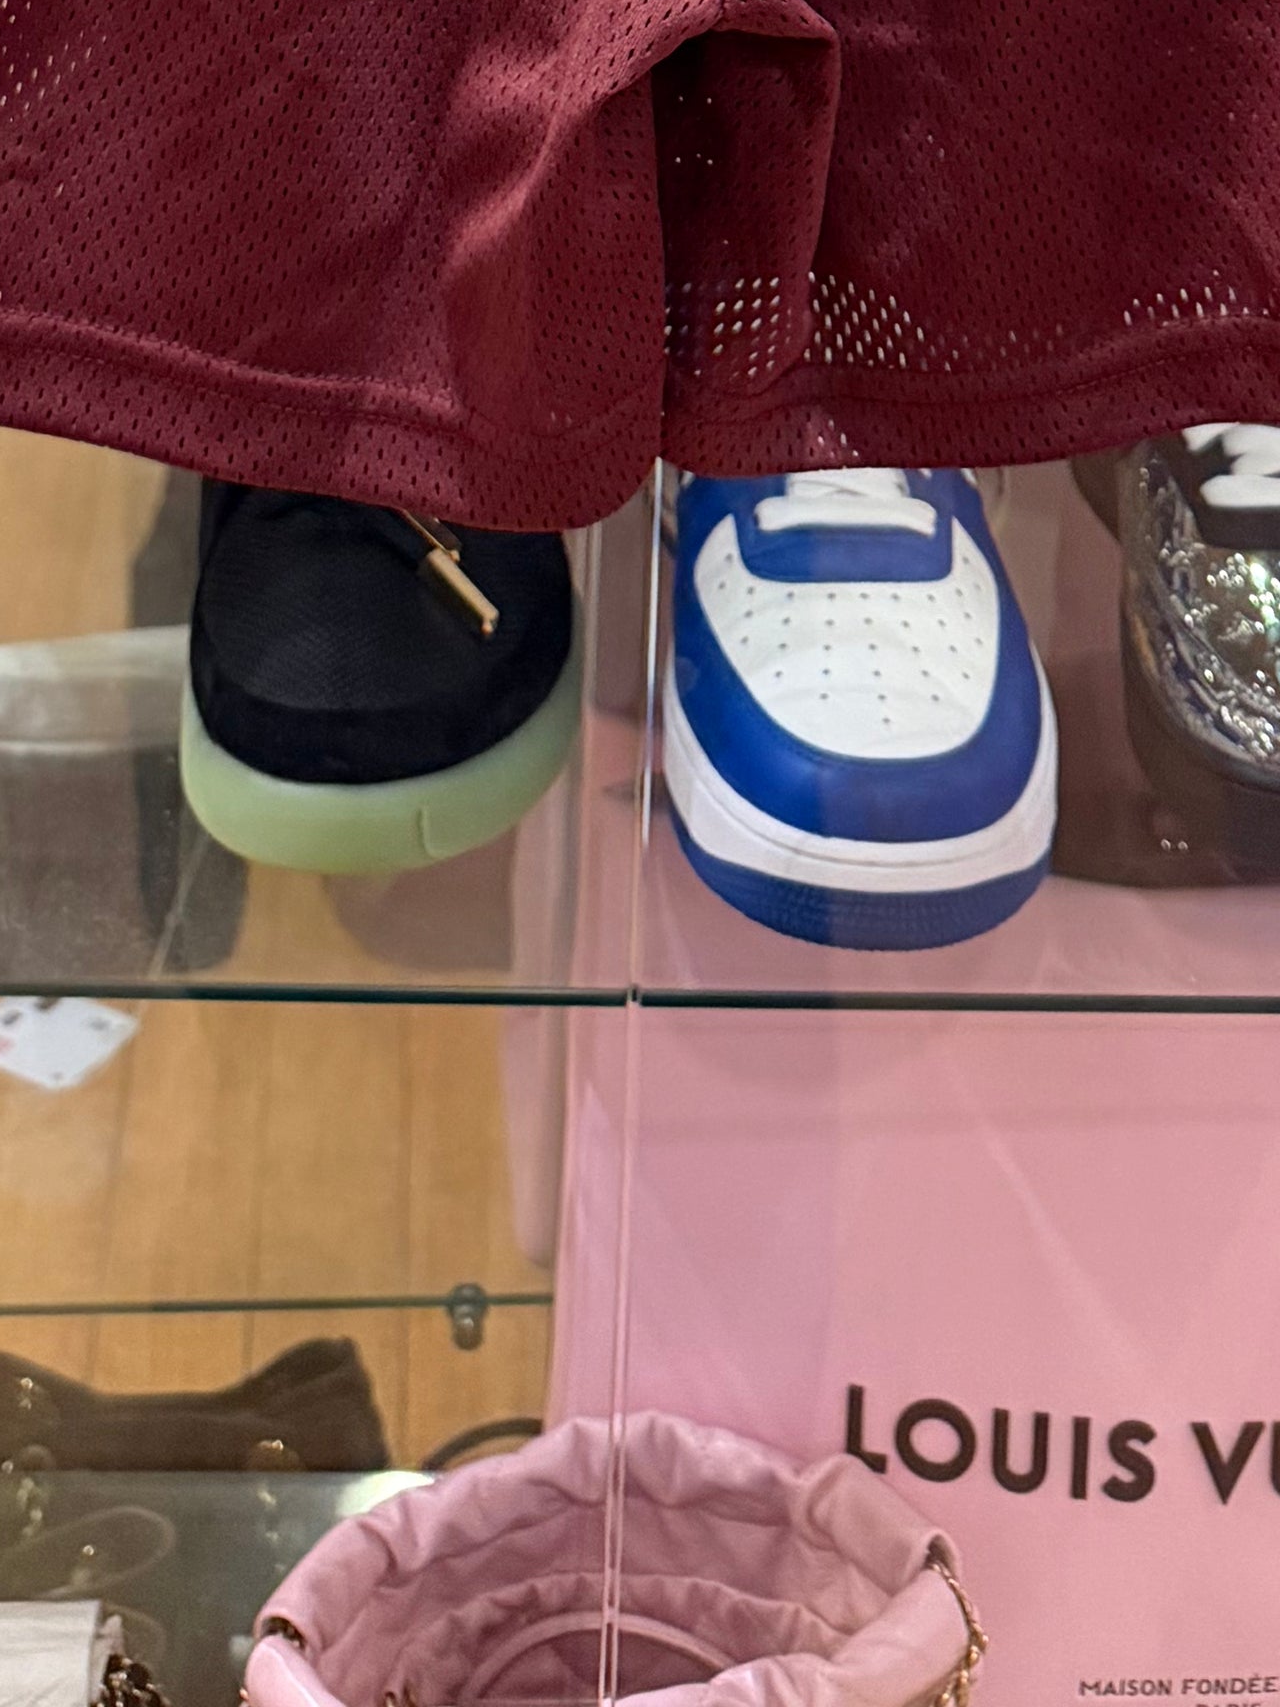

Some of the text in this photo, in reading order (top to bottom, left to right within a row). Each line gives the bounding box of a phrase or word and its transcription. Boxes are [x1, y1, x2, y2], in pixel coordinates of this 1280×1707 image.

[844, 1385, 1156, 1502] LOUIS
[1079, 1679, 1172, 1696] MAISON
[1181, 1674, 1279, 1695] FONDÉE
